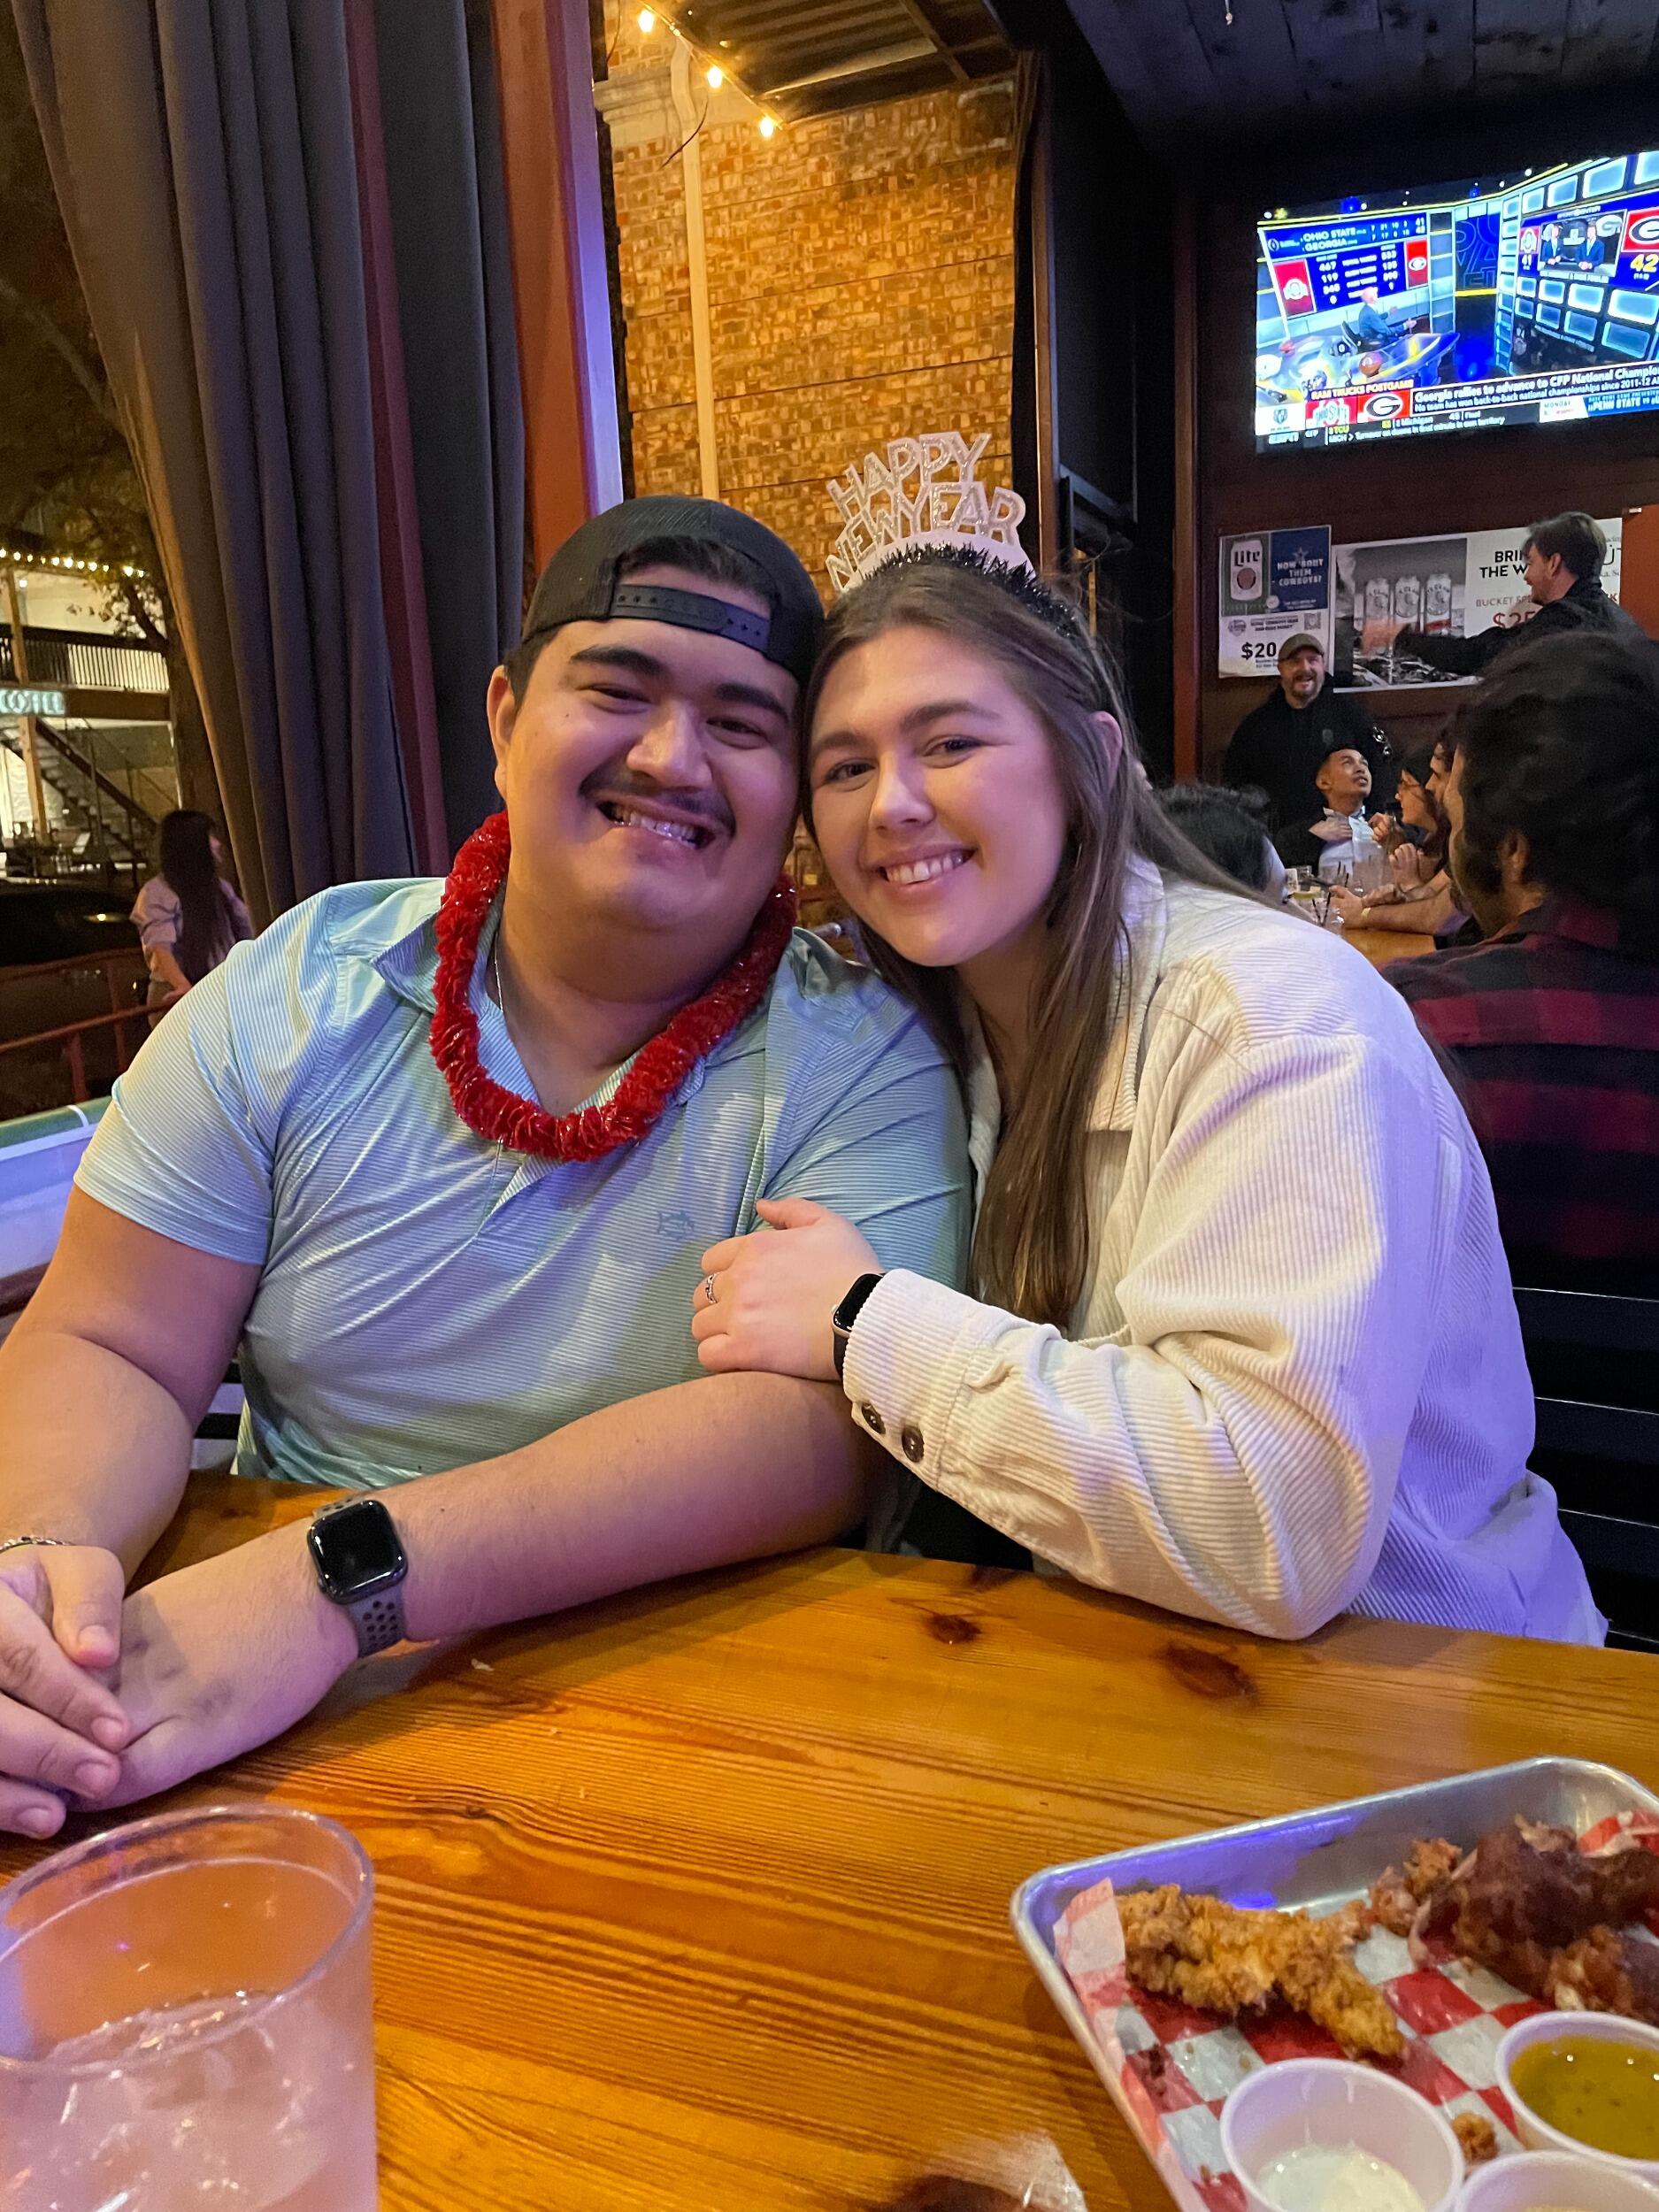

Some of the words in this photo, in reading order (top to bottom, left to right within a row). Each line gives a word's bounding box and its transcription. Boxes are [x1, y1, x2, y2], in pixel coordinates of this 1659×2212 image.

[1303, 230, 1329, 242] OHIO
[1331, 227, 1356, 238] STATE
[1305, 238, 1348, 251] GEORGIA
[1521, 254, 1532, 266] 41
[1630, 254, 1659, 273] 42
[1333, 385, 1365, 397] TRUCKS
[1366, 380, 1414, 394] POSTGAME
[1415, 389, 1453, 403] Georgia
[1454, 387, 1482, 398] rallies
[1483, 385, 1494, 395] to
[1495, 380, 1536, 395] advance
[1537, 378, 1548, 388] to
[1549, 374, 1571, 388] CFP
[1572, 370, 1614, 386] National
[1415, 403, 1426, 412] No
[1426, 402, 1445, 411] team
[1519, 389, 1548, 401] national
[1548, 384, 1601, 397] championships
[1601, 381, 1620, 391] since
[1620, 378, 1651, 388] 2011-12
[1616, 396, 1641, 409] STATE
[1268, 432, 1299, 444] ESPN
[826, 431, 992, 524] HAPPY
[825, 485, 901, 592] NEW
[893, 480, 1026, 546] YEAR
[1234, 549, 1261, 567] Lite
[1494, 549, 1522, 563] BRI
[1277, 561, 1296, 571] HOW
[1288, 568, 1312, 578] THEM
[1479, 565, 1509, 579] THE
[1476, 595, 1514, 608] BUCKET
[1516, 595, 1532, 604] SPE
[1241, 641, 1277, 661] $20
